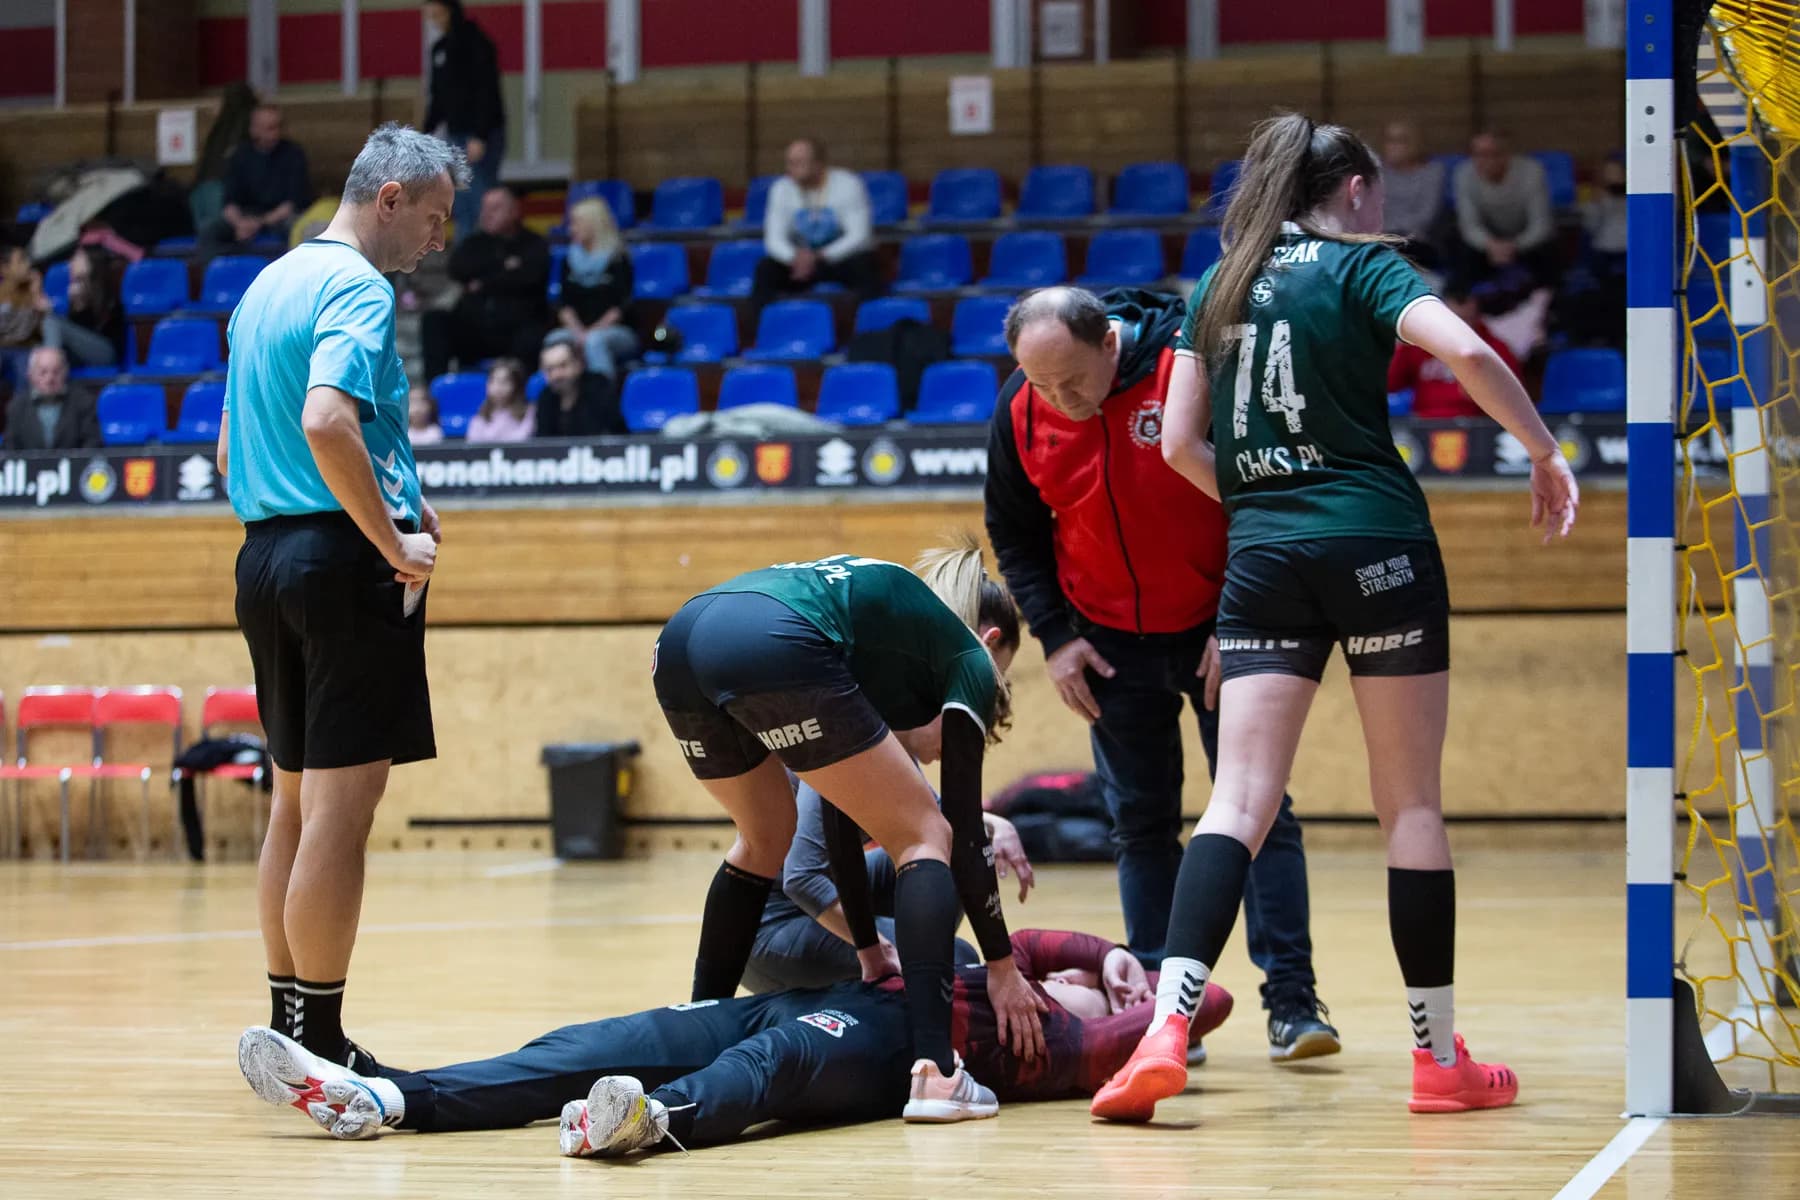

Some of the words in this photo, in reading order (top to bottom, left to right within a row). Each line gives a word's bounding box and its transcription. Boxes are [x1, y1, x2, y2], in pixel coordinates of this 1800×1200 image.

[1221, 319, 1306, 439] 74
[0, 457, 70, 506] ll.pl
[1355, 561, 1385, 581] SHOW
[1386, 555, 1410, 571] YOUR
[1360, 568, 1414, 596] STRENGTH
[757, 718, 823, 750] HARE
